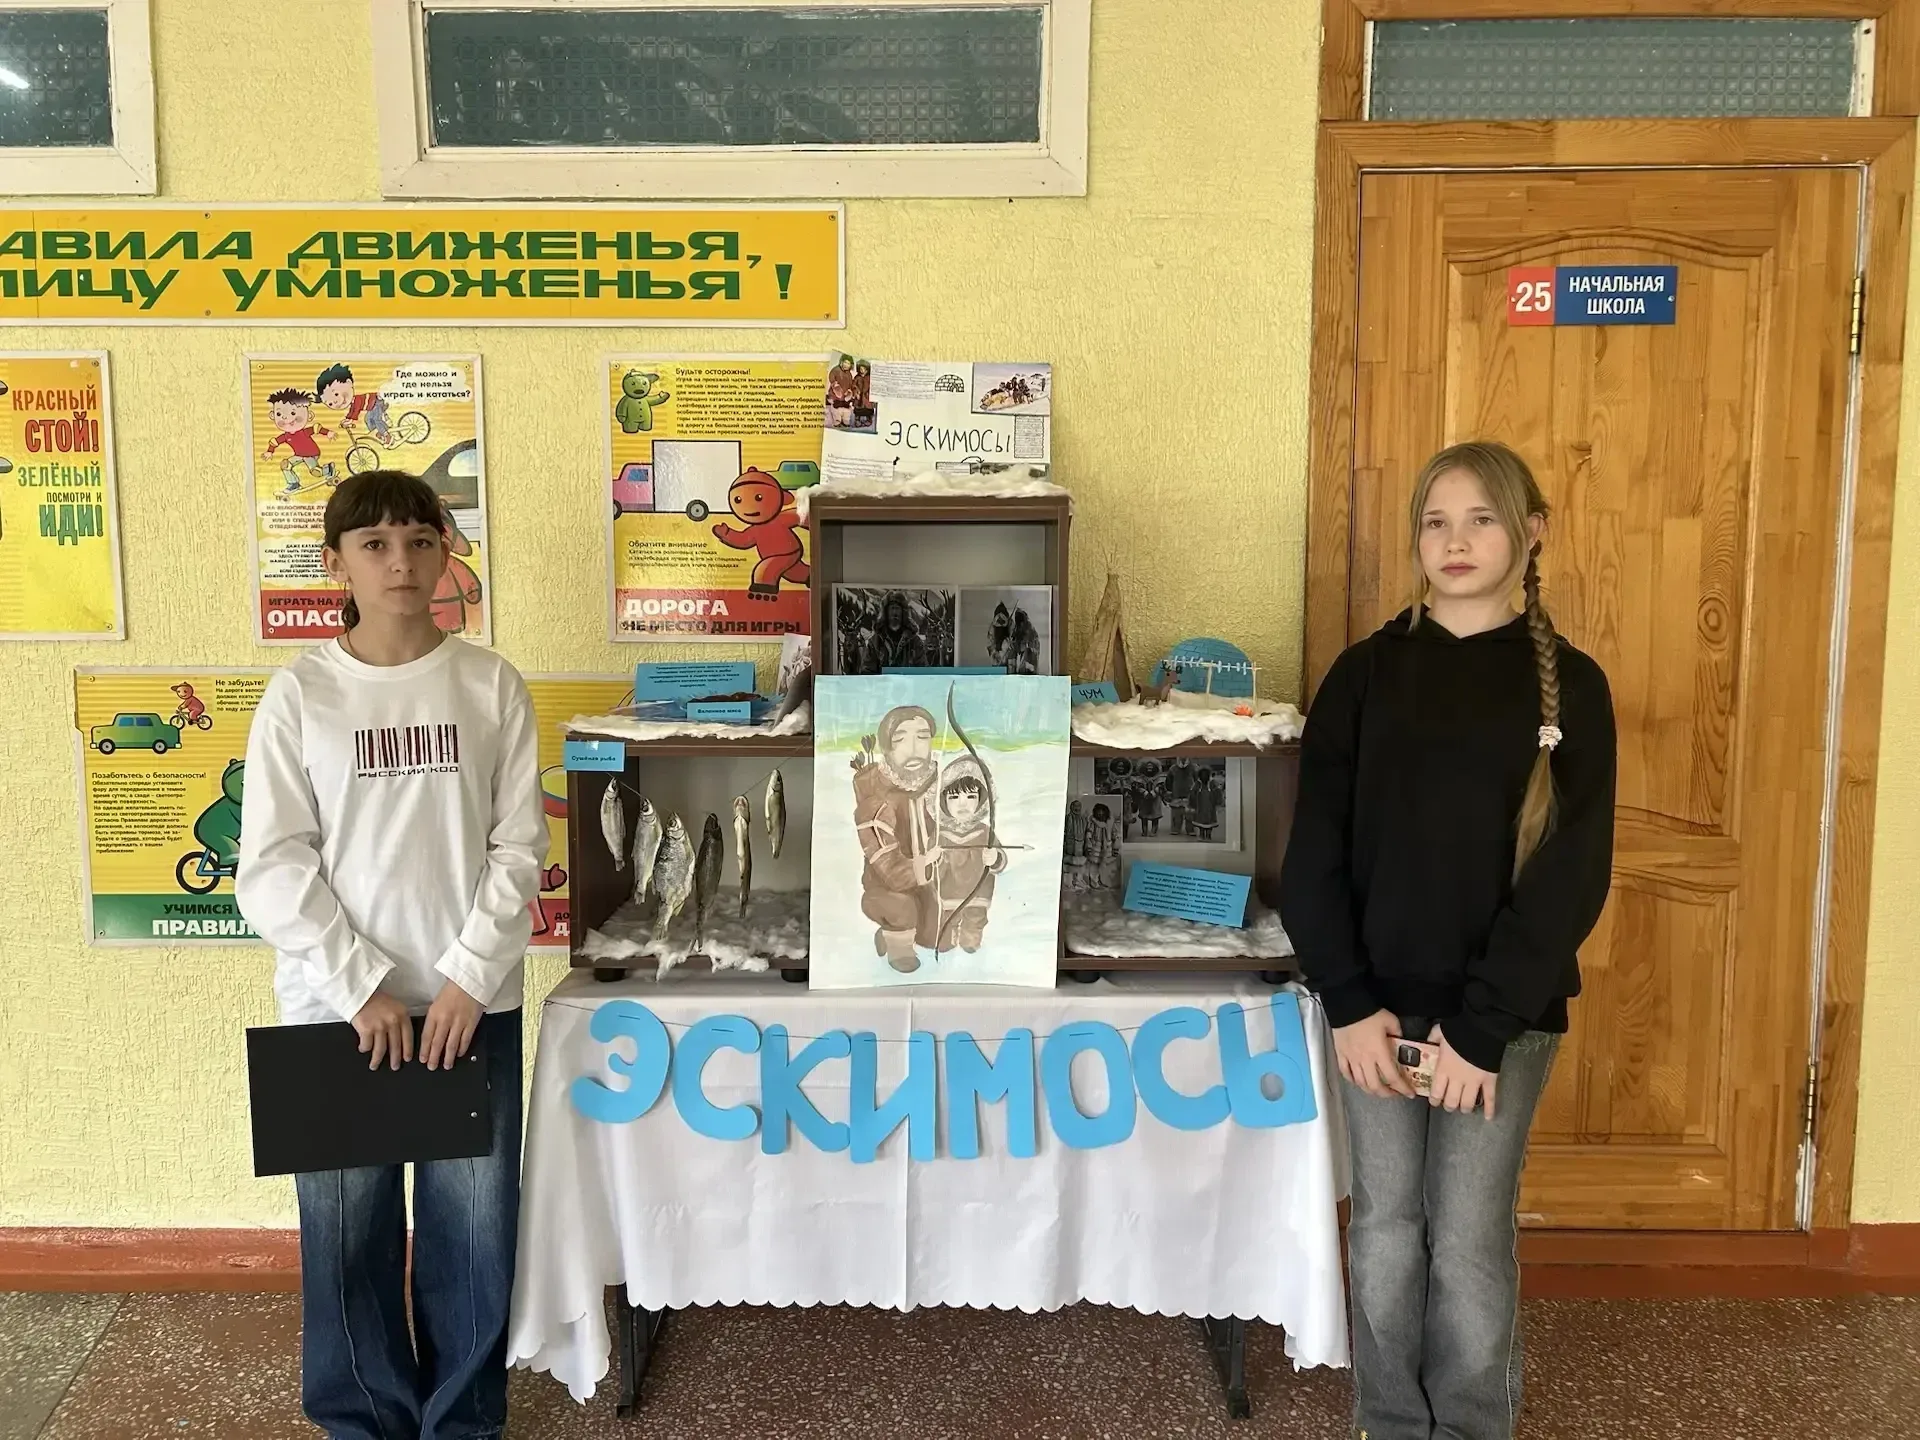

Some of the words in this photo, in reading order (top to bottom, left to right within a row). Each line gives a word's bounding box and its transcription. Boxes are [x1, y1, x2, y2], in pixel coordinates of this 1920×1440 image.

[0, 231, 253, 260] АВИЛА
[288, 231, 762, 269] ДВИЖЕНЬЯ,
[221, 269, 740, 312] УМНОЖЕНЬЯ
[1569, 276, 1664, 293] НАЧАЛЬНАЯ
[1515, 281, 1551, 312] 25
[1587, 298, 1646, 315] ШКОЛА
[396, 370, 412, 379] Где
[675, 368, 703, 376] Будьте
[704, 368, 751, 376] осторожны!
[12, 384, 97, 411] КРАСНЫЙ
[384, 392, 414, 400] играть
[426, 390, 471, 398] кататься?
[25, 411, 100, 453] СТОЙ!
[885, 421, 1010, 453] ЭСКИМОСЫ
[18, 461, 102, 487] ЗЕЛЁНЫЙ
[46, 492, 91, 503] ПОСМОТРИ
[96, 492, 102, 503] И
[39, 504, 104, 546] ИДИ!
[628, 540, 666, 548] Обратите
[268, 598, 315, 606] ИГРАТЬ
[317, 598, 334, 606] НА
[624, 598, 729, 618] ДОРОГА
[710, 621, 747, 634] ДЛЯ
[751, 621, 801, 632] ИГРЫ
[228, 678, 264, 687] забудьте!
[1078, 688, 1105, 700] ЧУМ
[153, 772, 207, 780] безопасности!
[163, 904, 233, 915] УЧИМСЯ
[571, 992, 1319, 1163] ЭСКИМОСЫ
